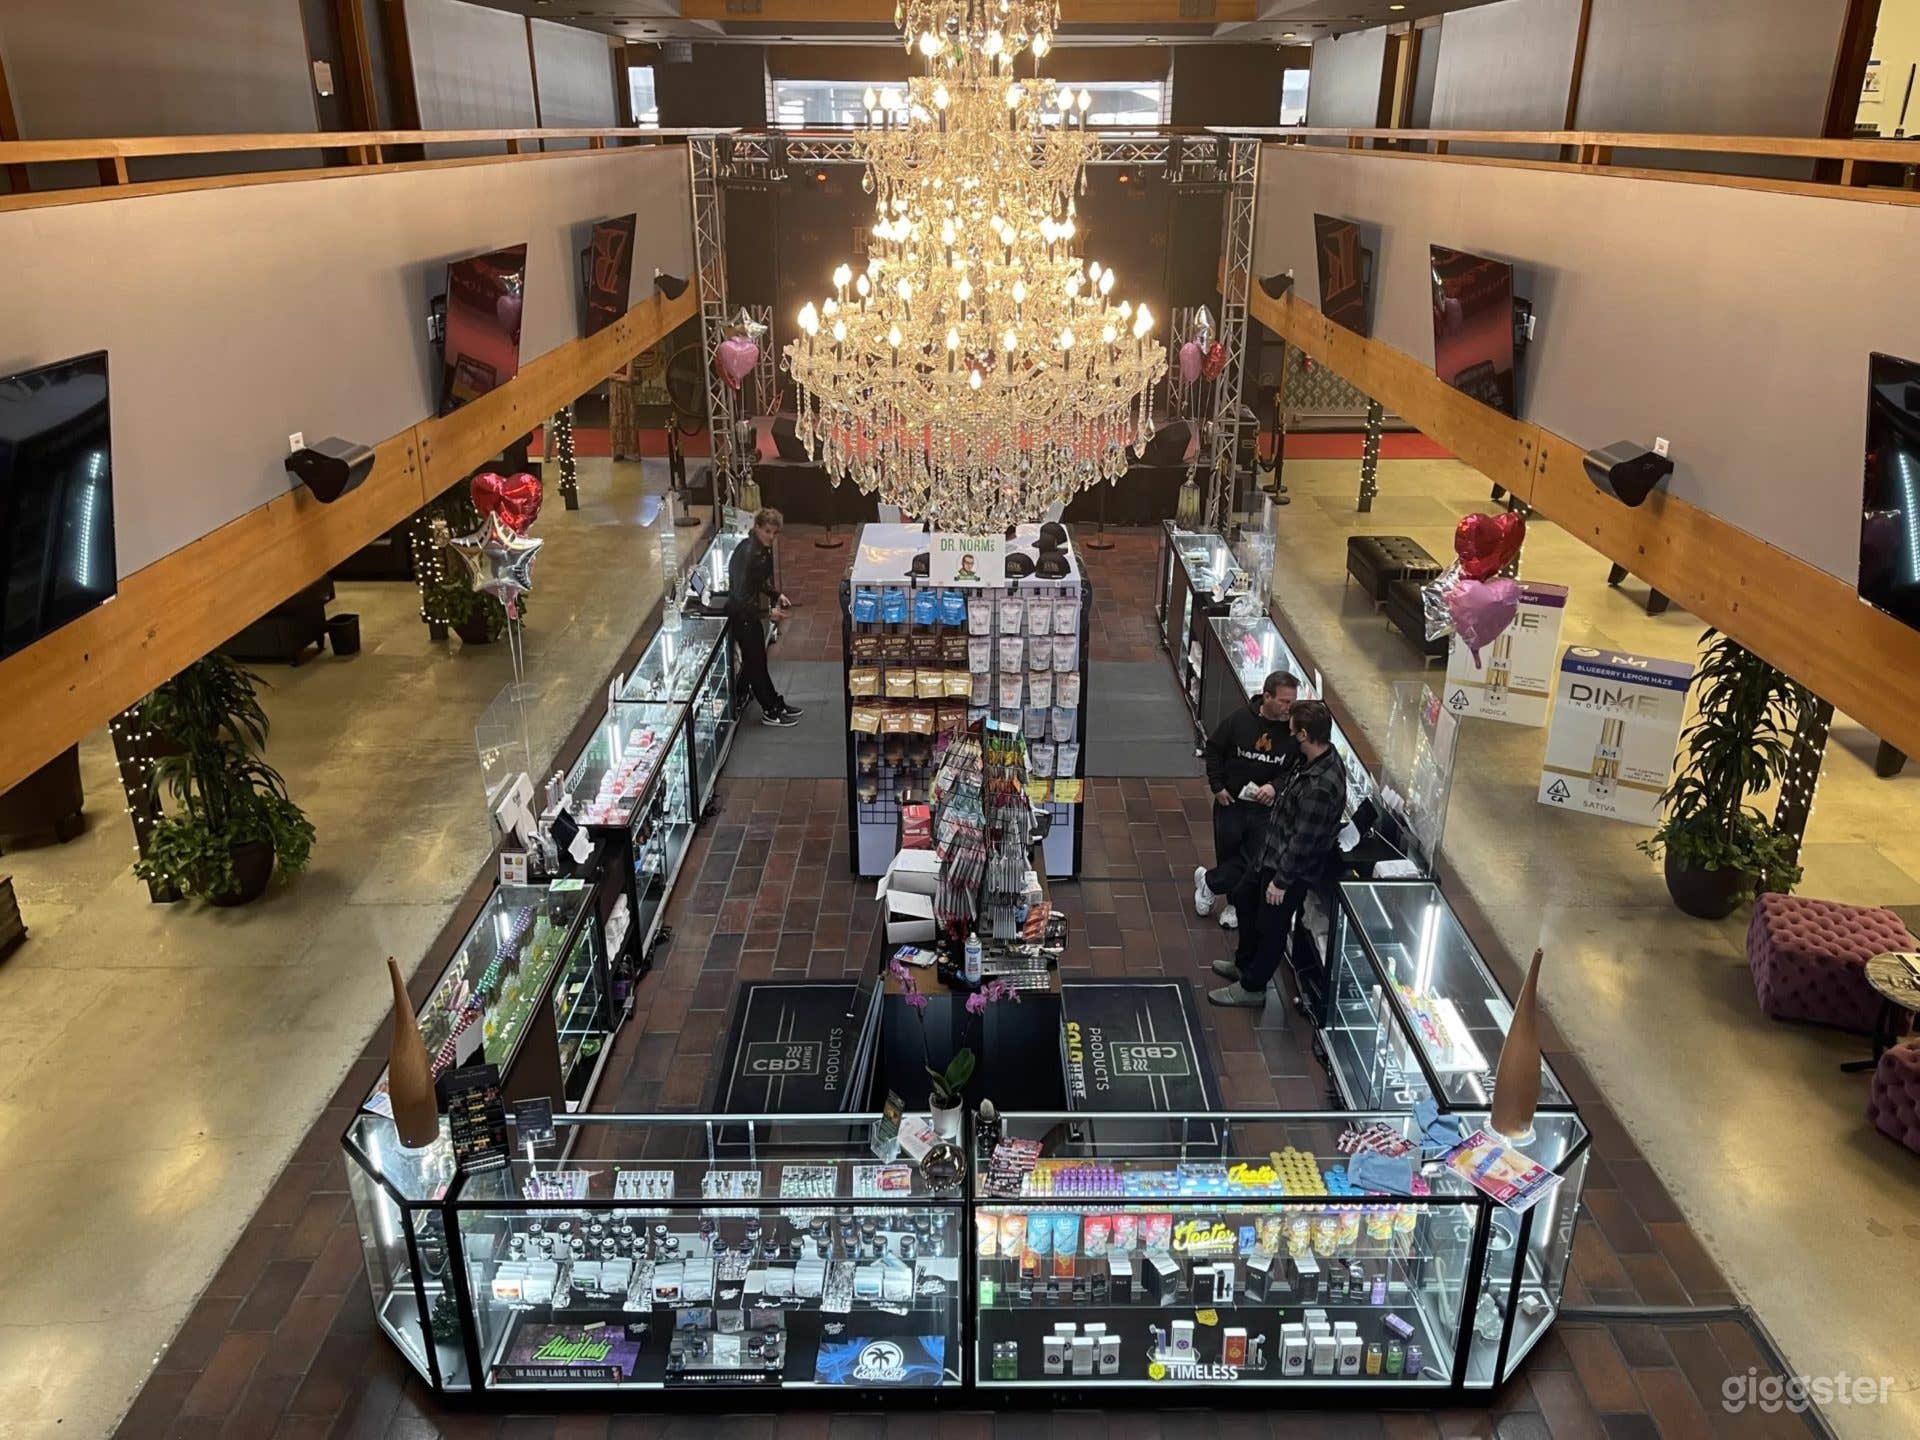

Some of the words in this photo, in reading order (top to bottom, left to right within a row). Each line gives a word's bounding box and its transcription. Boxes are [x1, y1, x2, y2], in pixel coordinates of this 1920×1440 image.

[1576, 664, 1621, 679] BLUEBERRY
[1621, 671, 1650, 682] LEMON
[1650, 676, 1674, 687] HAZE
[1569, 683, 1661, 713] DIME
[1237, 746, 1287, 766] NAPALM
[1551, 795, 1564, 804] CA
[1582, 800, 1616, 813] SATIVA
[801, 1046, 813, 1070] LIVING
[824, 1027, 844, 1091] PRODUCTS
[1088, 1027, 1110, 1091] PRODUCTS
[1119, 1046, 1132, 1071] LIVING
[1130, 1047, 1177, 1059] CBD
[752, 1059, 801, 1072] CBD
[526, 1368, 548, 1377] ALIEN
[549, 1369, 568, 1378] LABS
[569, 1370, 582, 1378] WE
[583, 1370, 606, 1378] TRUST
[1167, 1365, 1239, 1381] TIMELESS
